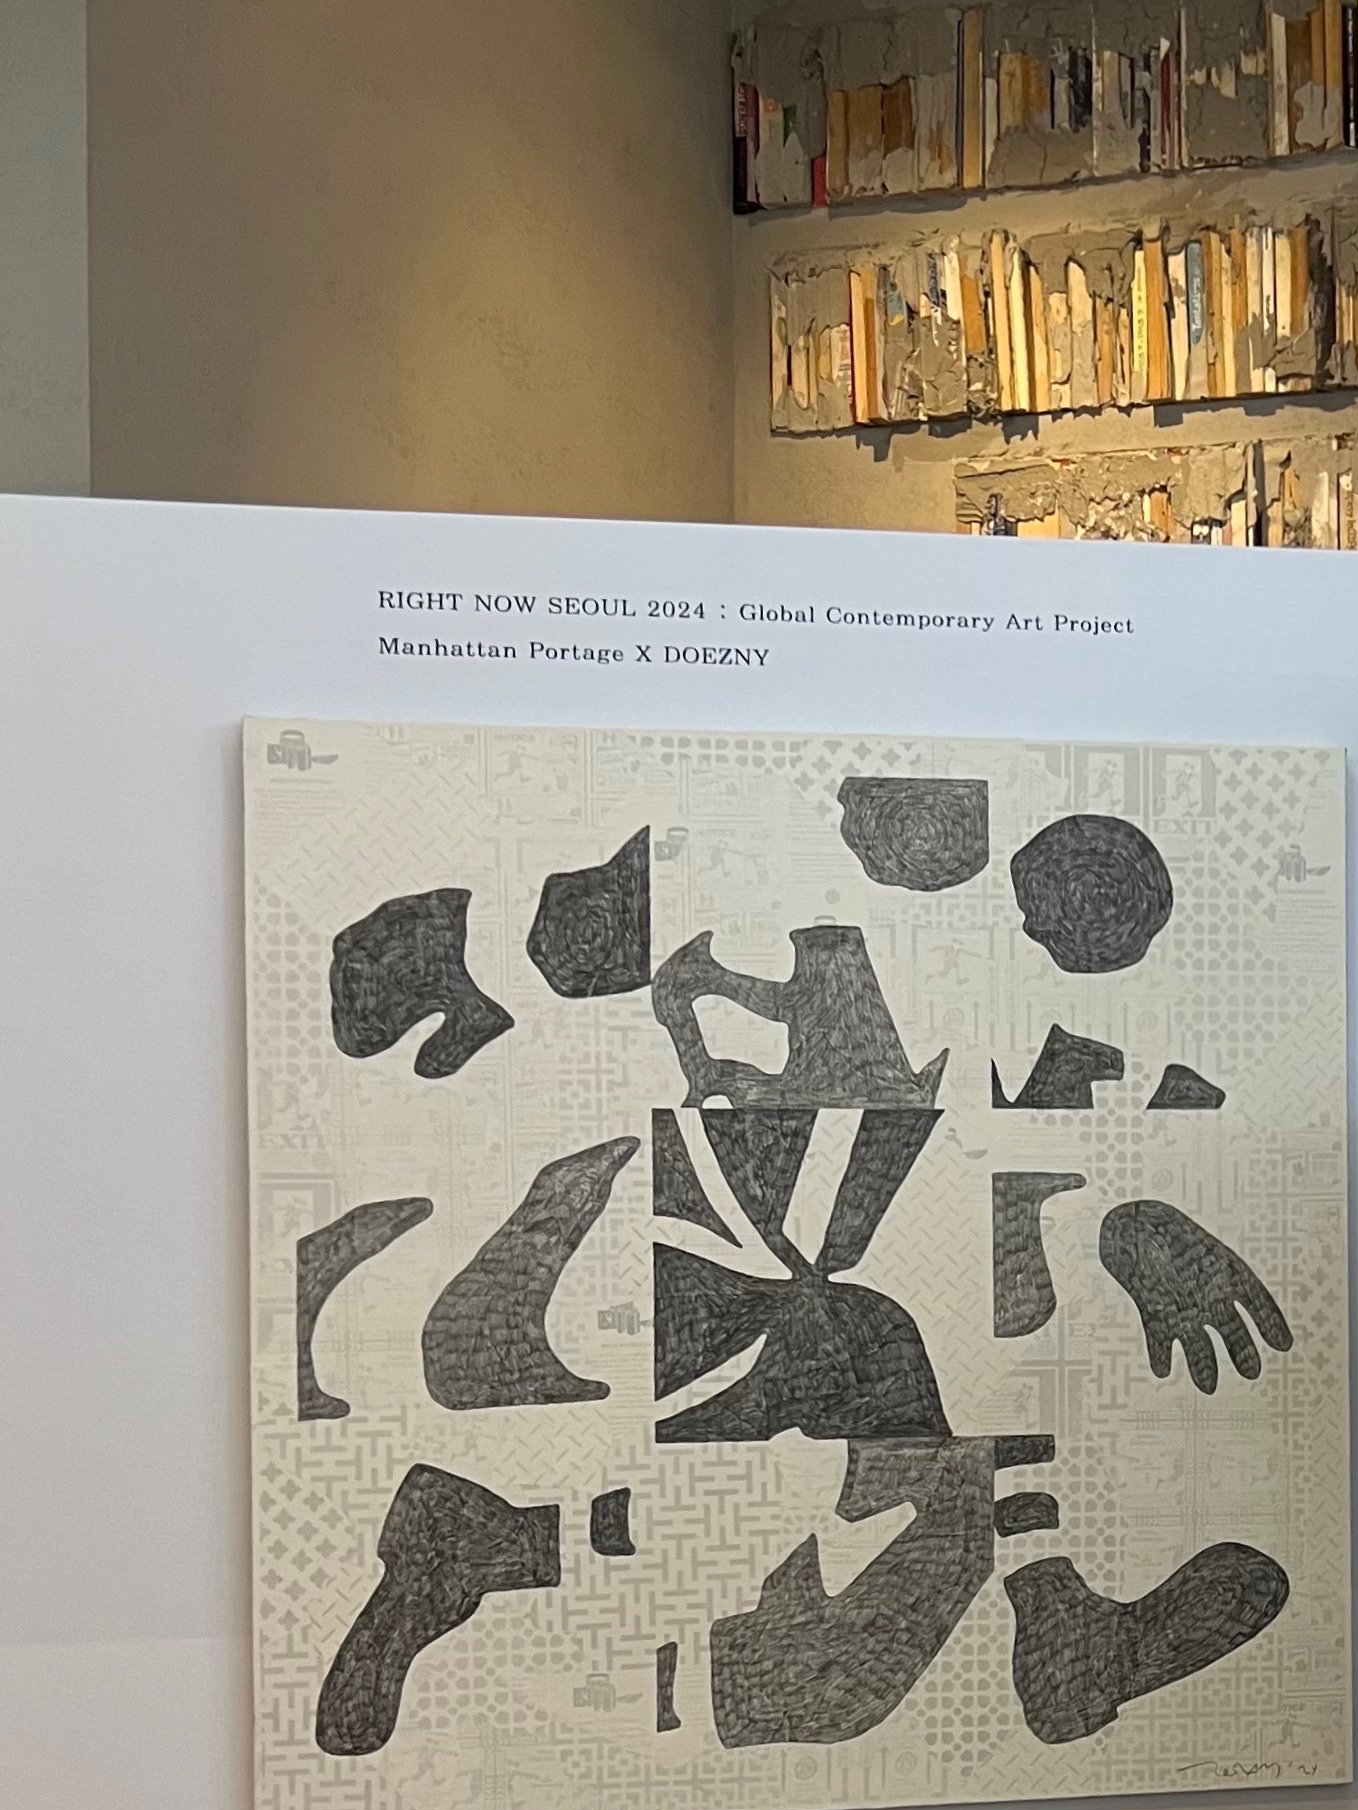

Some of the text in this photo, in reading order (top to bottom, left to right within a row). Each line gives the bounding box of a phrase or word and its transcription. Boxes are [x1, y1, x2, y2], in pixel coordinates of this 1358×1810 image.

[378, 590, 464, 612] RIGHT
[474, 593, 537, 614] NOW
[548, 596, 637, 617] SEOUL
[647, 599, 705, 620] 2024
[739, 603, 815, 624] Global
[826, 606, 995, 633] Contemporary
[1005, 613, 1044, 631] Art
[1053, 614, 1134, 636] Project
[378, 636, 770, 667] Manhattan Portage X DOEZNY
[1152, 818, 1218, 836] EXIT
